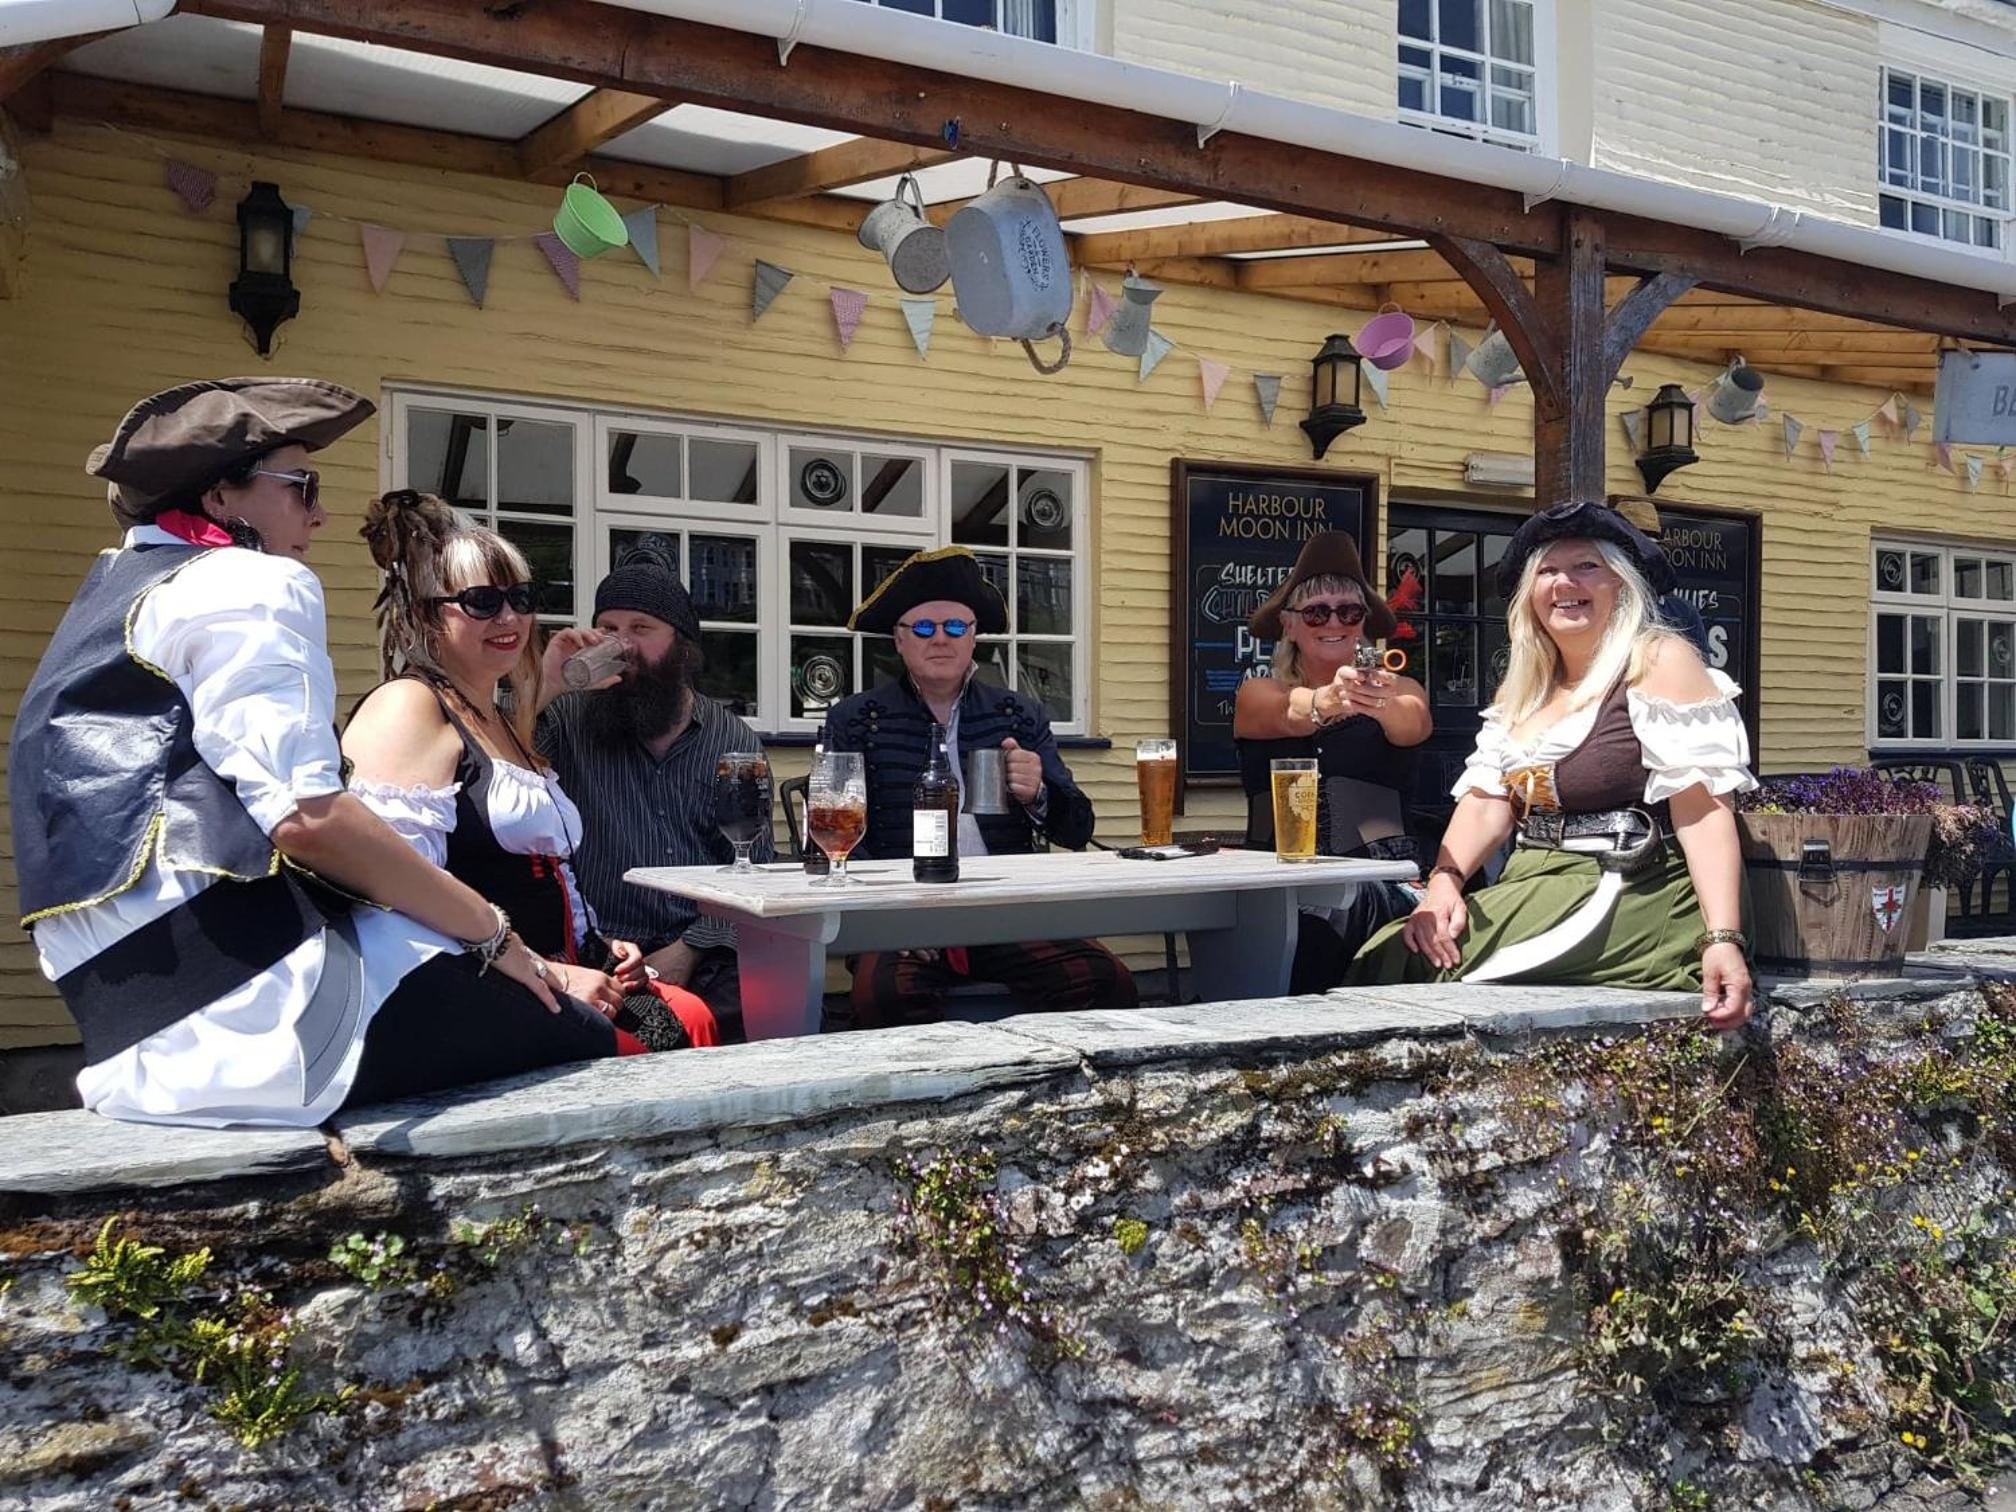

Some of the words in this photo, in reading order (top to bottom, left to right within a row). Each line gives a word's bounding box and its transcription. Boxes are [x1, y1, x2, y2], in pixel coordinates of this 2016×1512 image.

[1228, 492, 1326, 519] HARBOUR
[1218, 516, 1290, 540] MOON
[1664, 528, 1723, 551] ARBOUR
[1701, 550, 1727, 571] INN
[1218, 561, 1295, 585] SHELTE
